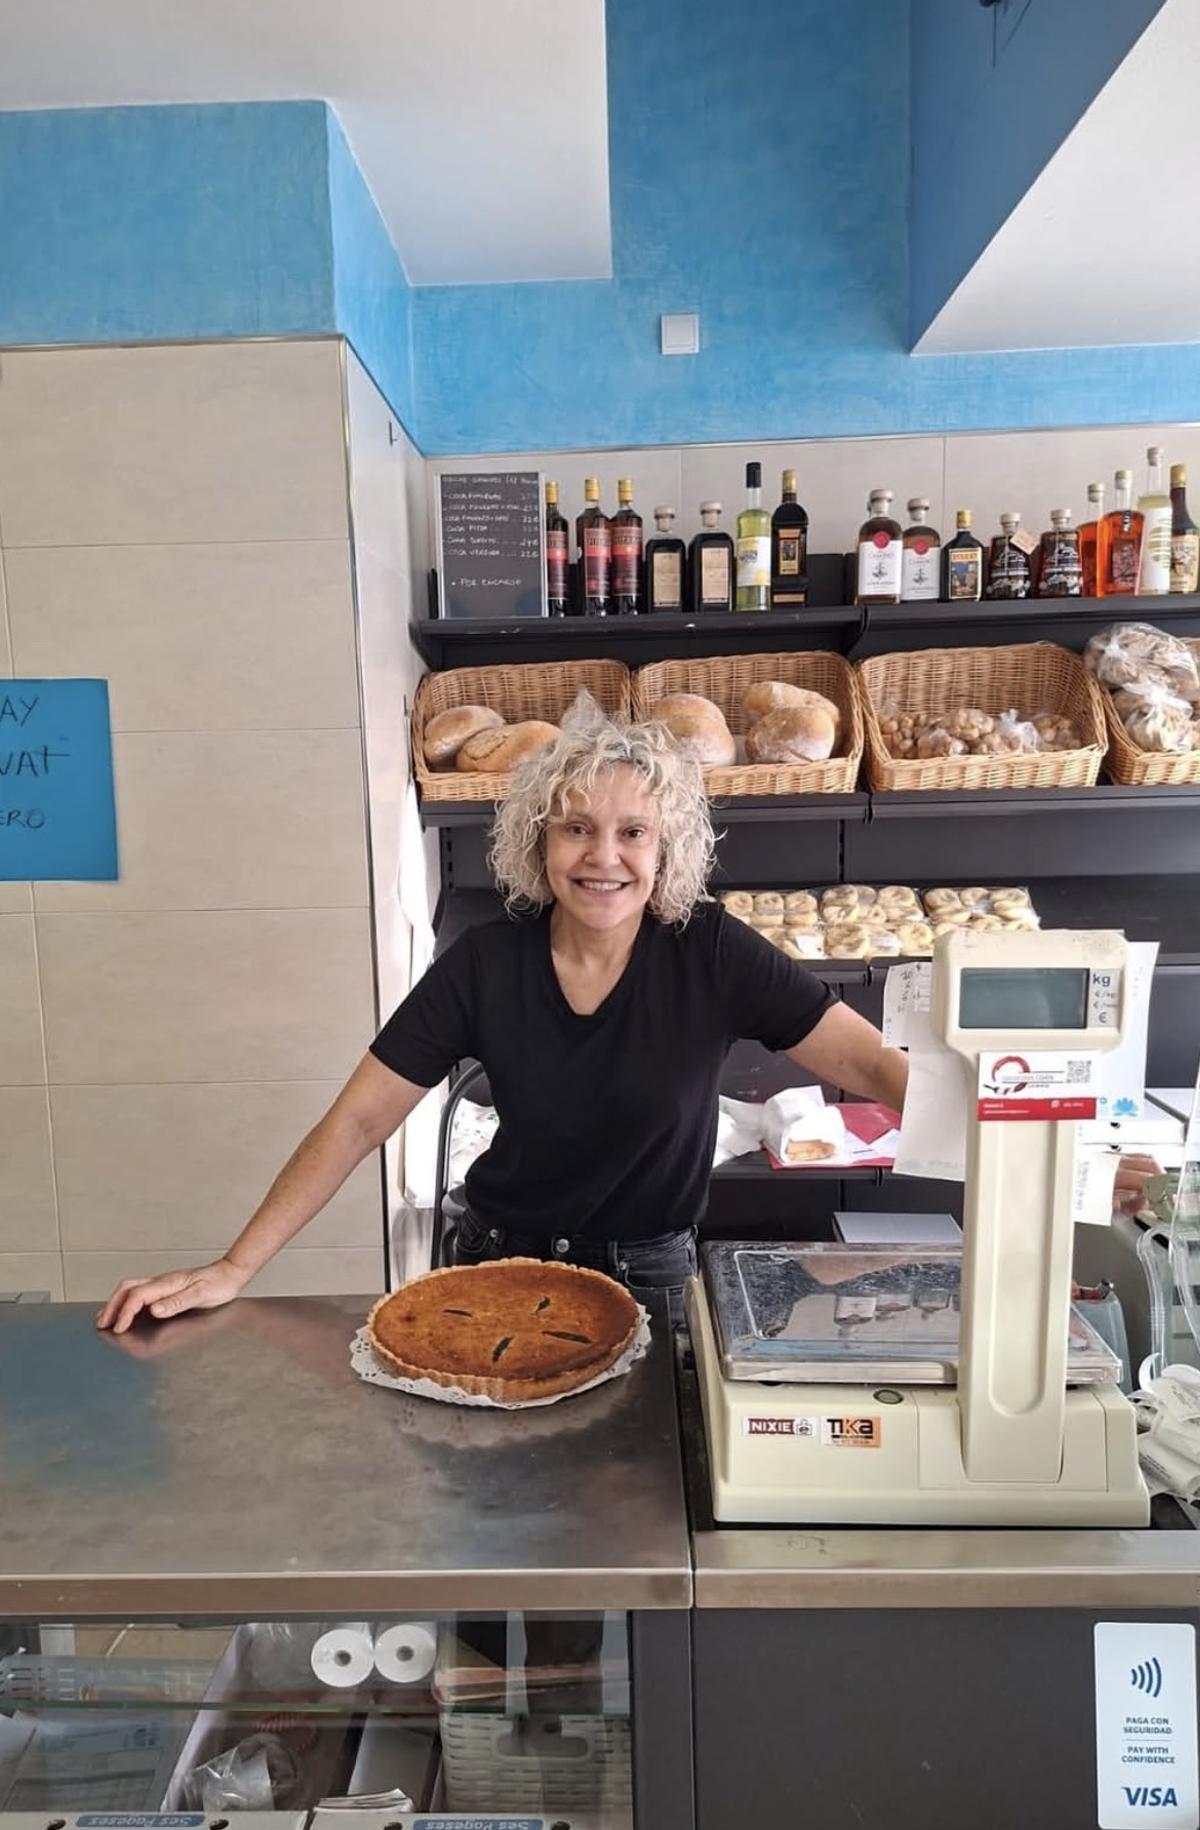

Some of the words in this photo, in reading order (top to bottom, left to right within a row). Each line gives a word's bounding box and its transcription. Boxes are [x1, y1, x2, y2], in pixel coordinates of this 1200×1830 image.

[1093, 973, 1111, 987] kg
[751, 1420, 791, 1433] NIXIE
[1150, 1717, 1169, 1725] CON
[1122, 1787, 1178, 1807] VISA
